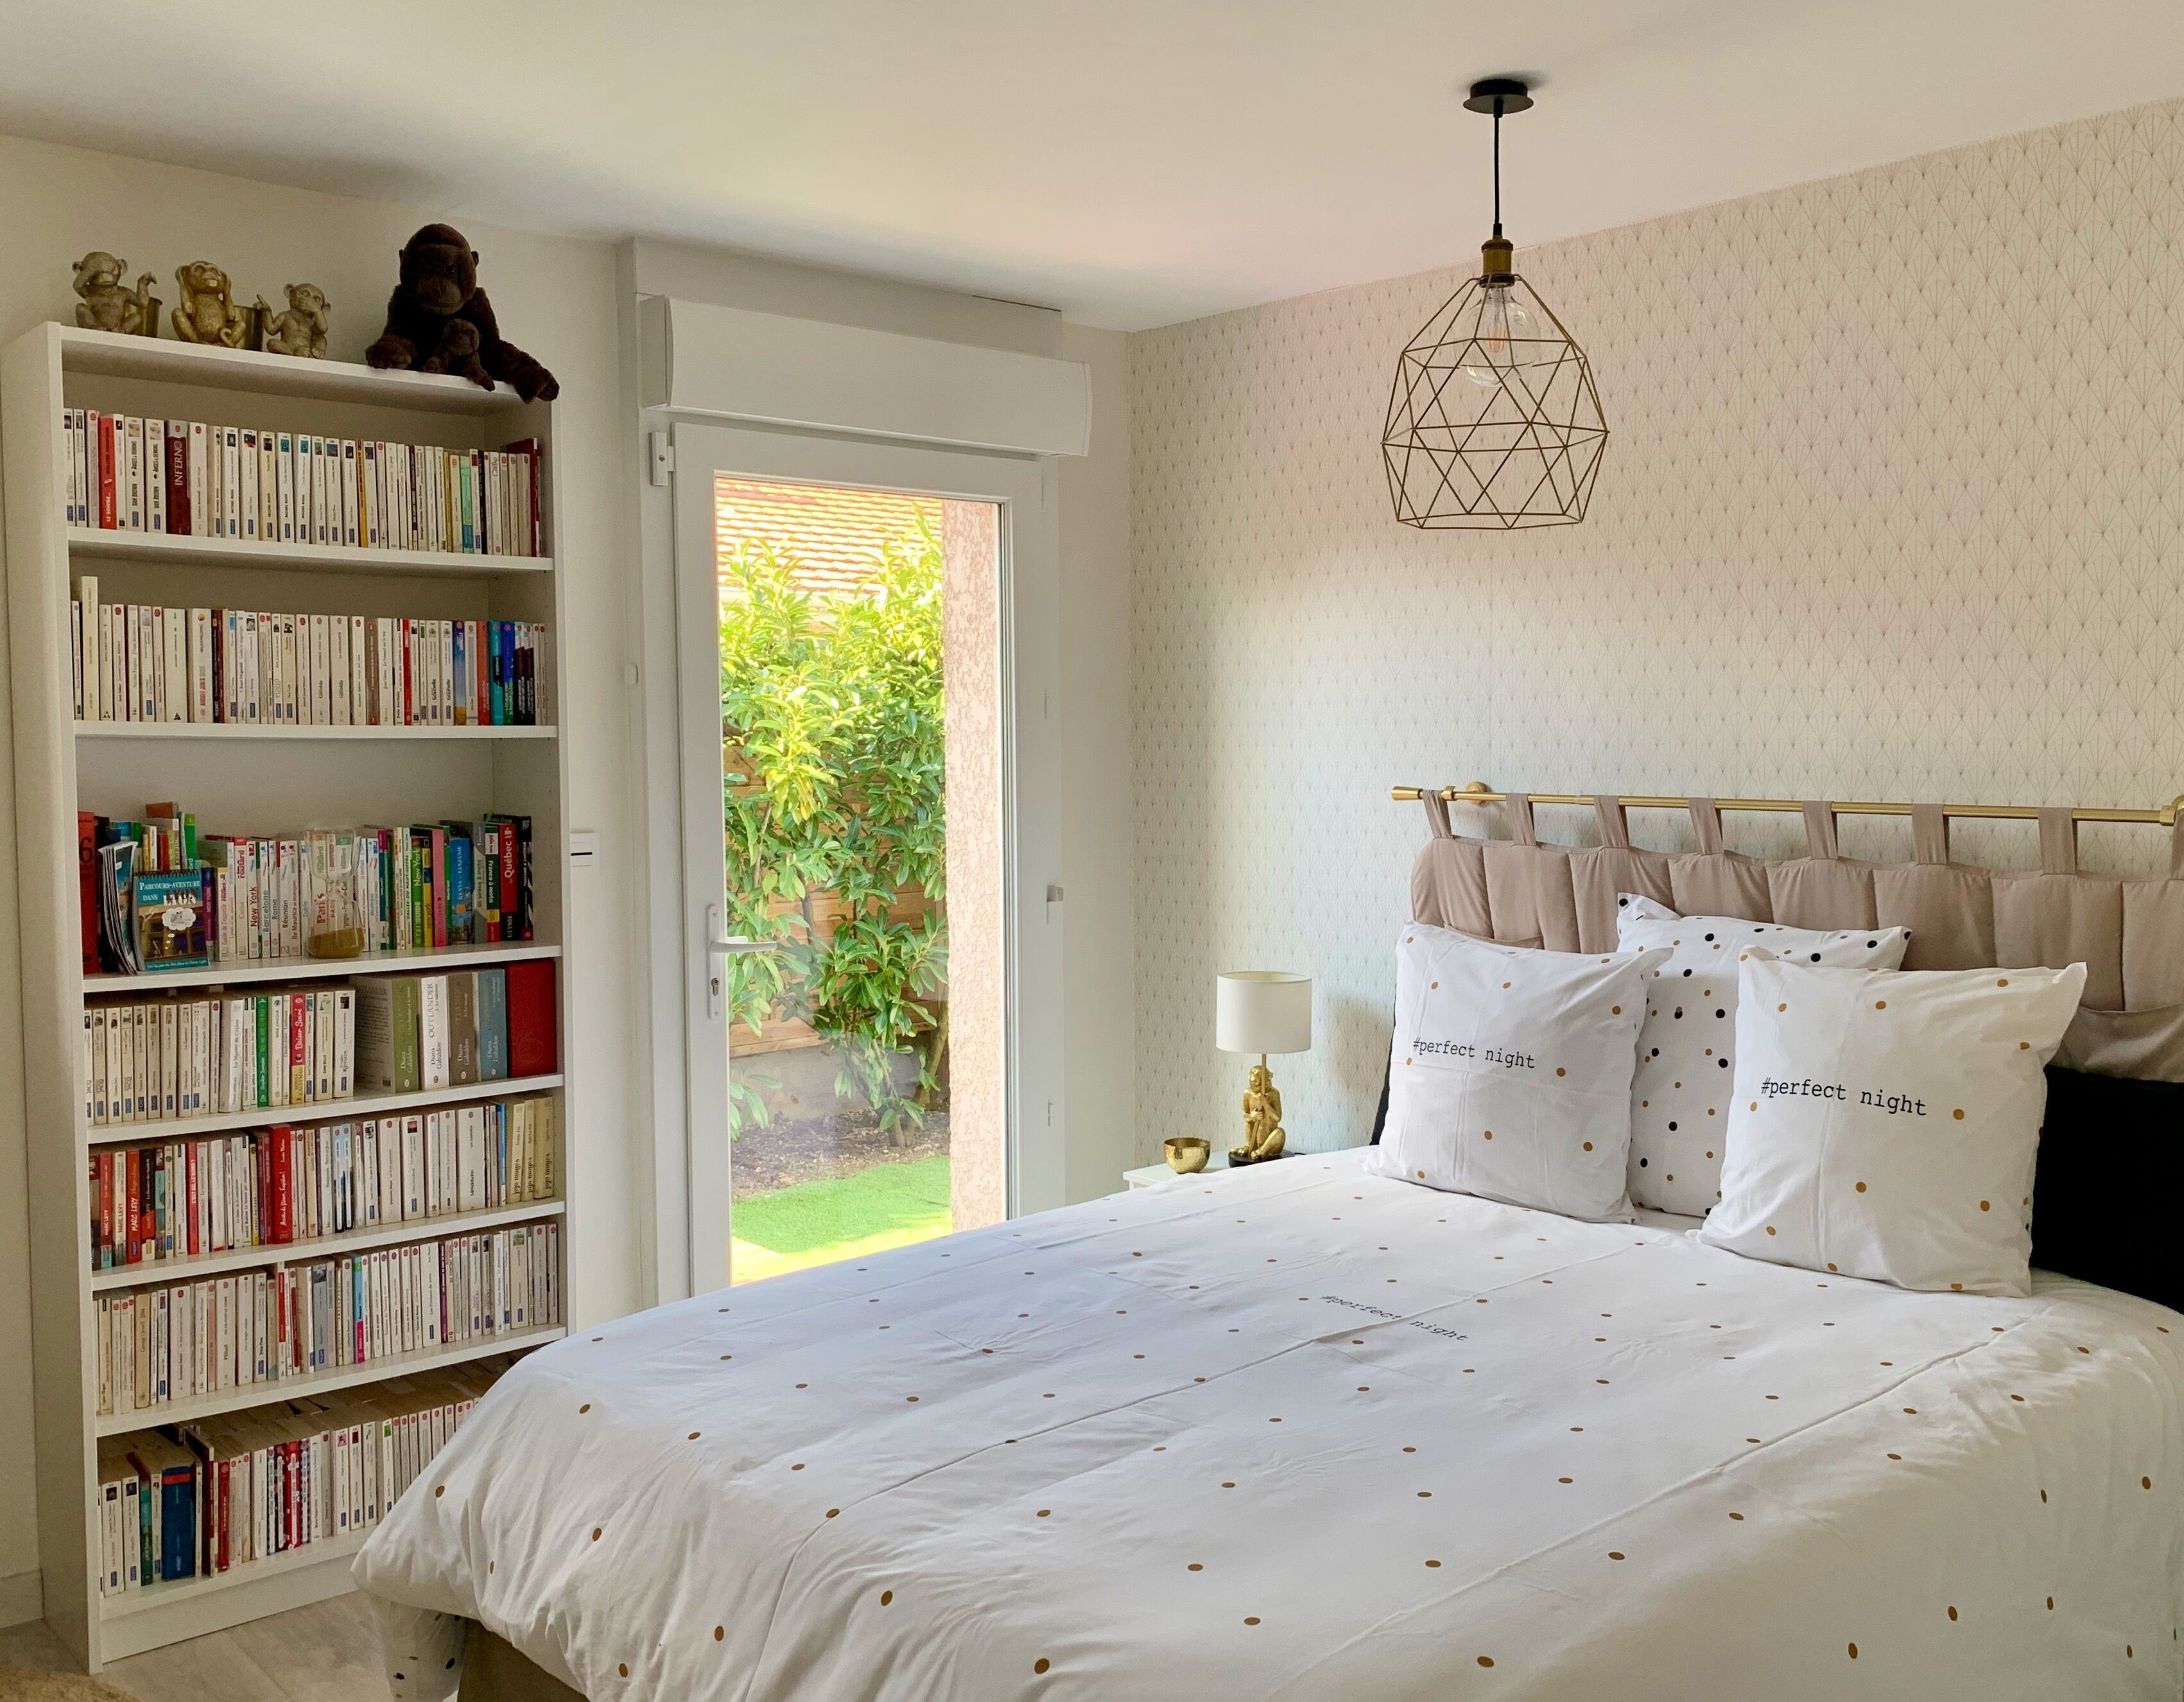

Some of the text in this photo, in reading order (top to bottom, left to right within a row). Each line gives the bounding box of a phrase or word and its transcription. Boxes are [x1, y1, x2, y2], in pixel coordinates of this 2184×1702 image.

[174, 440, 183, 485] INFERNO
[80, 837, 94, 864] 6
[412, 847, 420, 866] York
[503, 841, 514, 878] Québec
[139, 881, 200, 890] PARCOURS-AVENTURE
[314, 893, 325, 923] Paris
[1413, 1037, 1535, 1068] #perfect night
[1761, 1077, 1927, 1115] #perfect night
[1320, 1295, 1468, 1341] #perfect night
